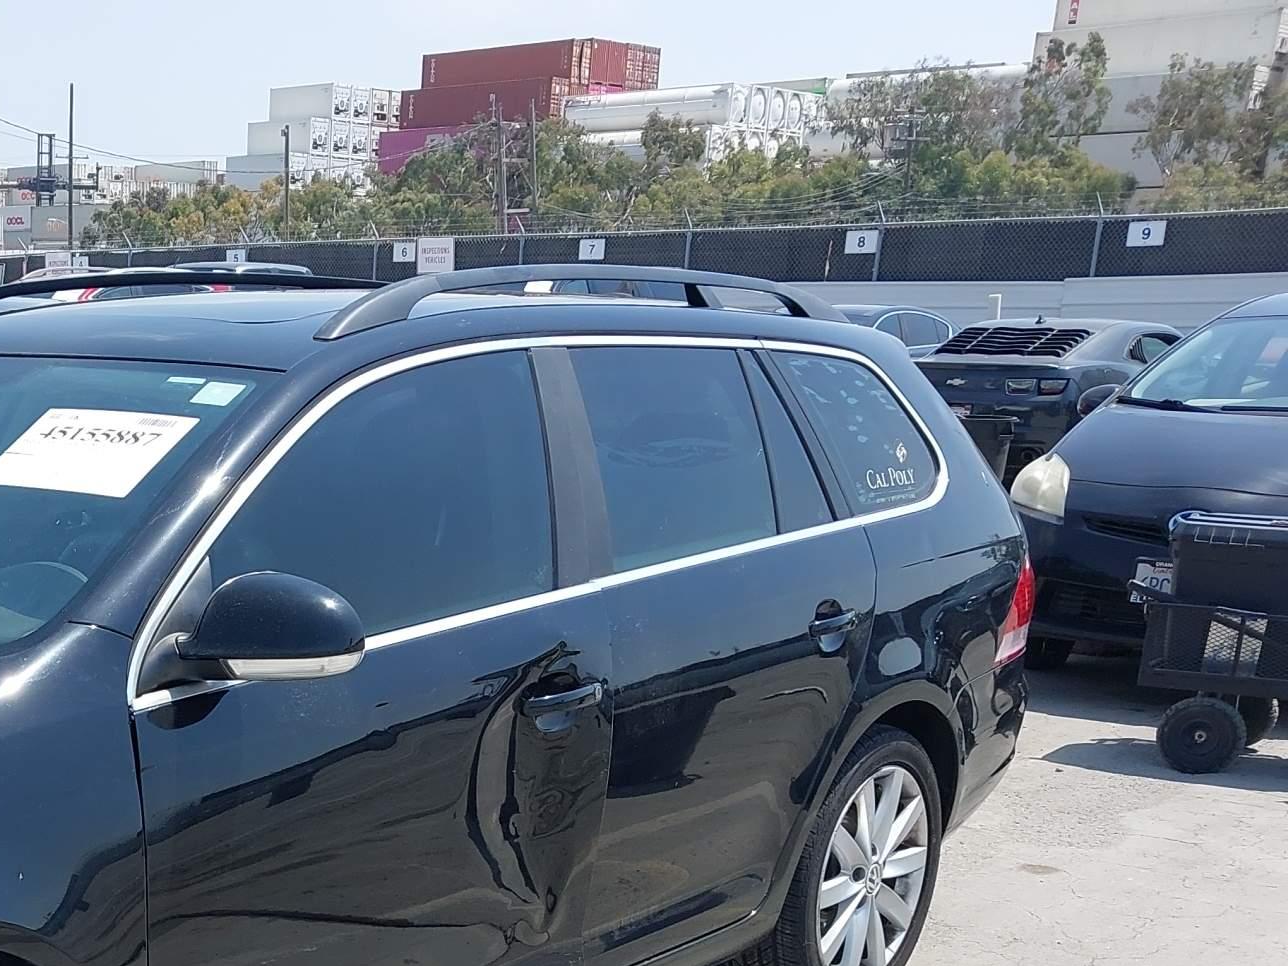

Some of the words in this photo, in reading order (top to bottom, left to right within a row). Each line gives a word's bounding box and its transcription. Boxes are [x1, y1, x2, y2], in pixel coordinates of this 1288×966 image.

[6, 216, 25, 226] OOCL
[1141, 227, 1152, 240] 9
[856, 235, 866, 248] 8
[401, 246, 408, 258] 6
[588, 243, 596, 255] 7
[233, 253, 239, 263] 5
[39, 425, 164, 446] 45155887
